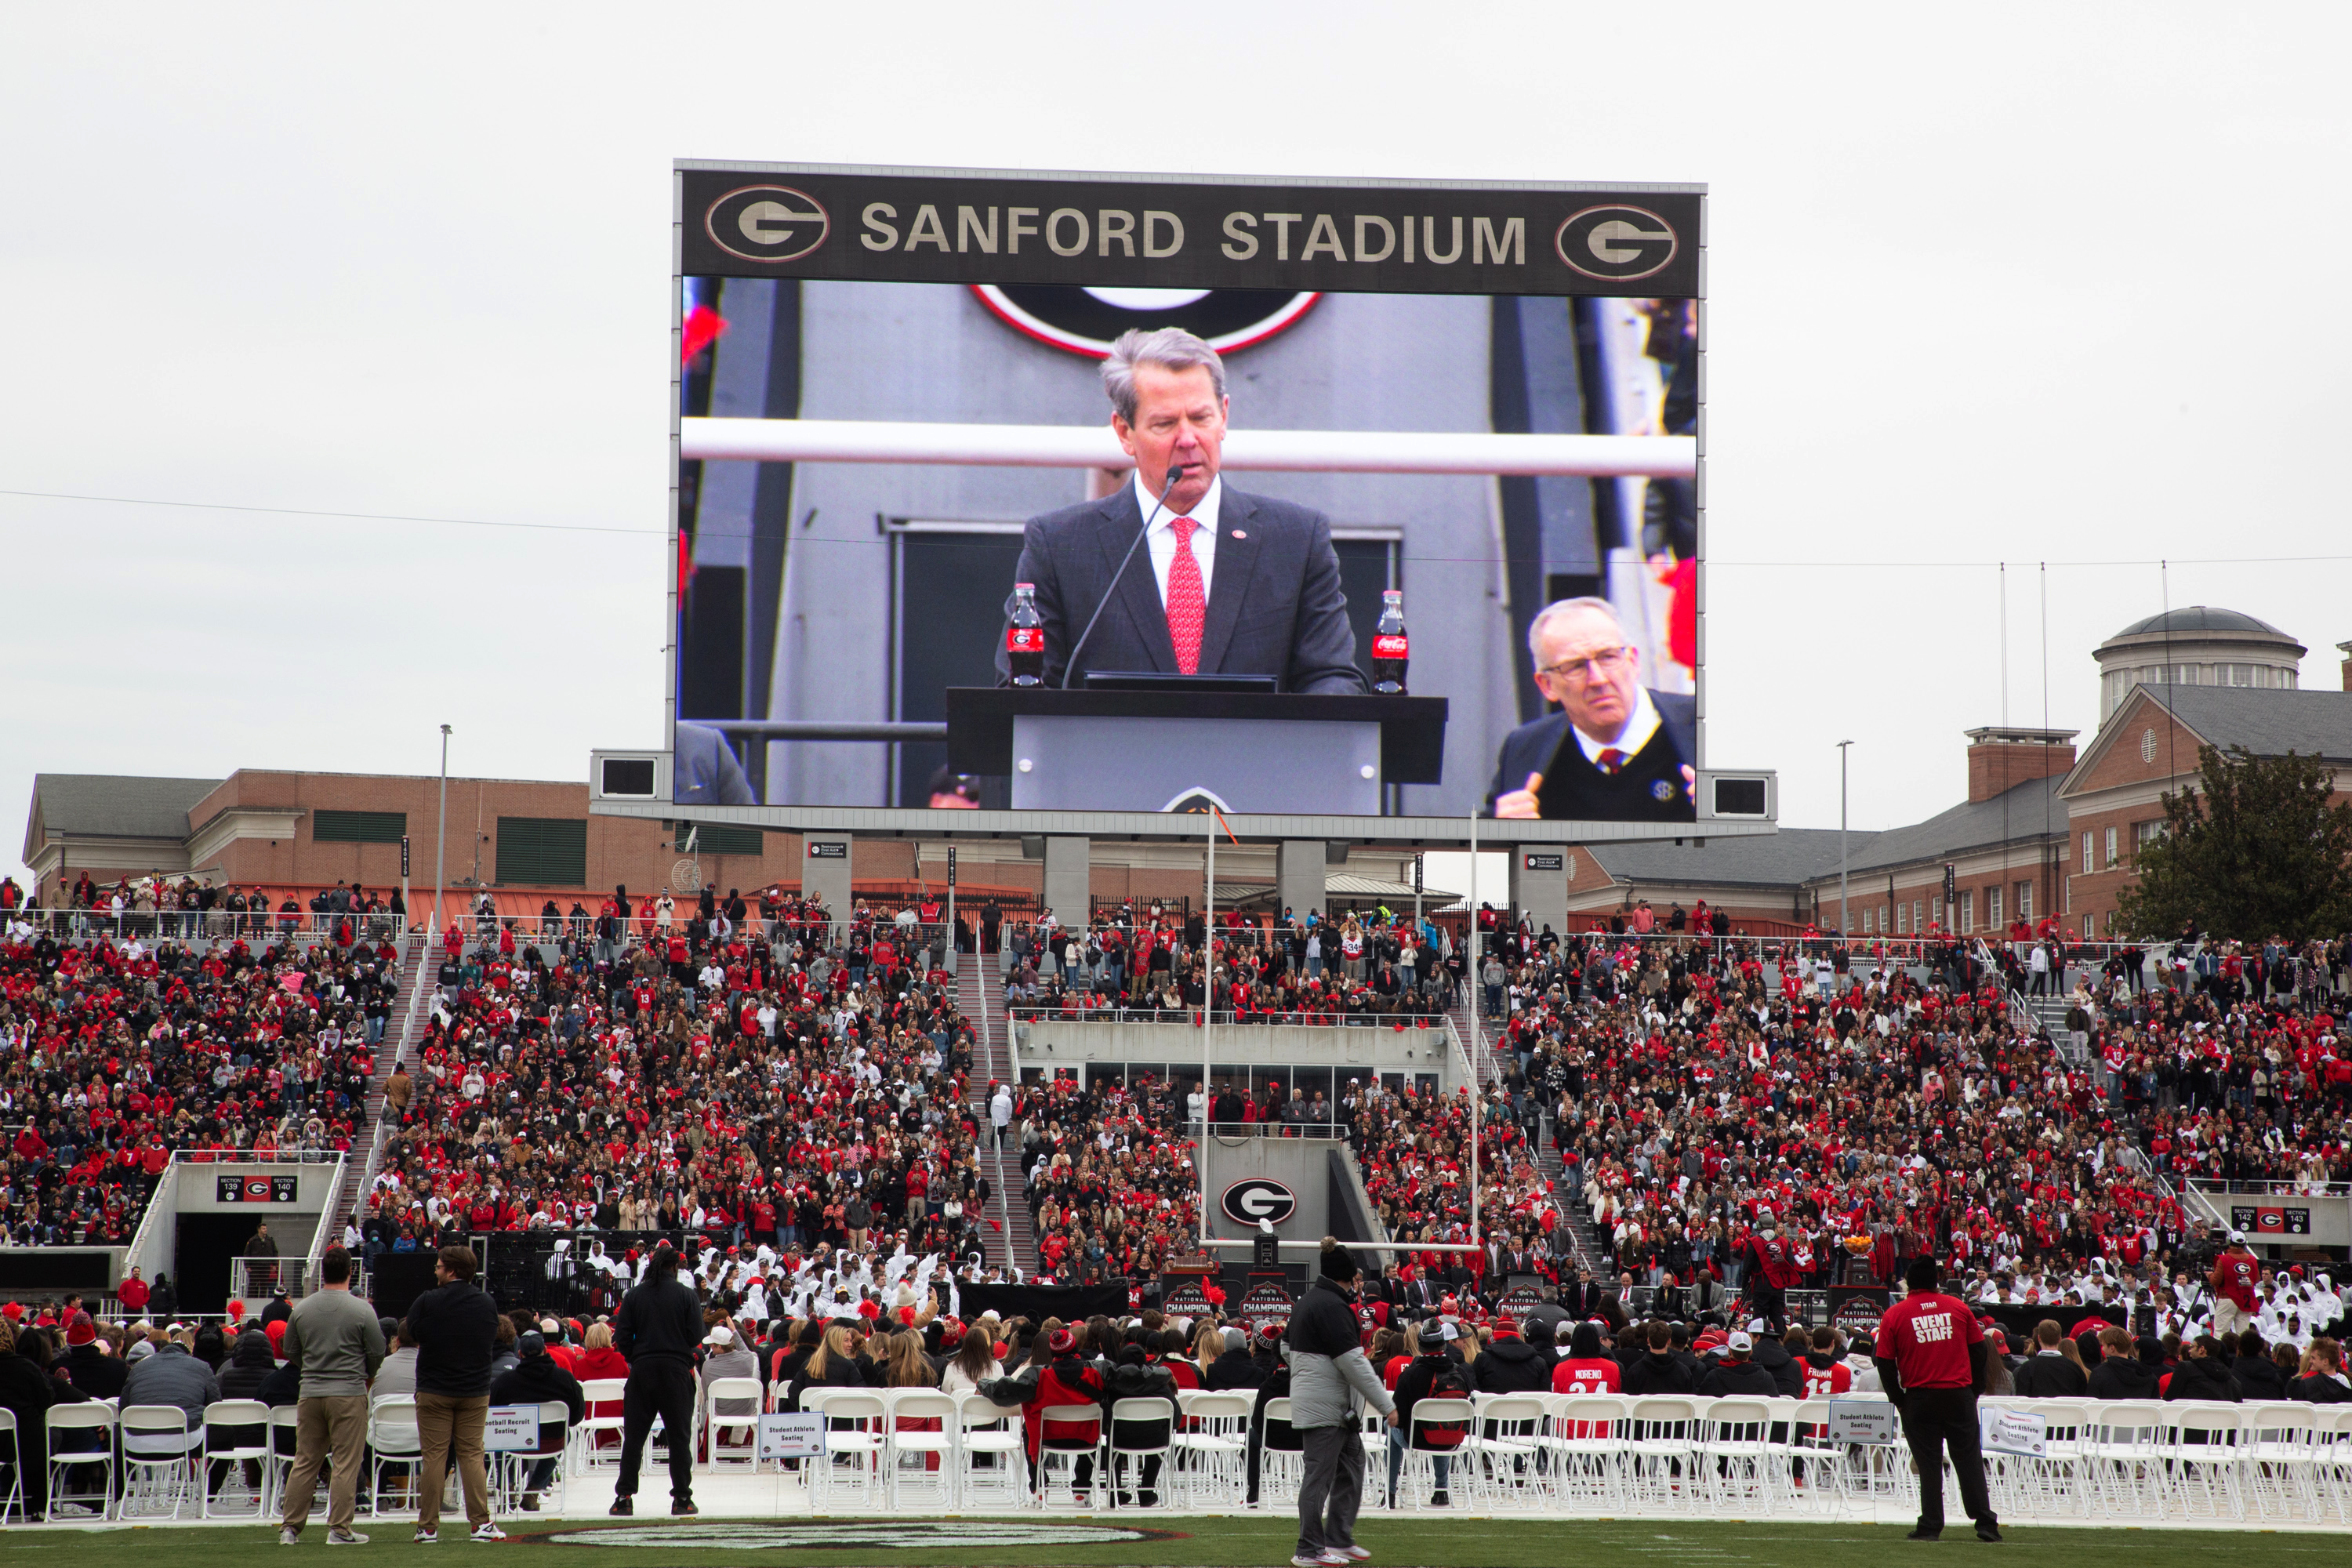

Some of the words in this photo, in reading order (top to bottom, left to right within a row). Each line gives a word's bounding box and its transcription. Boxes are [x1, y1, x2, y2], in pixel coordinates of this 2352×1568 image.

[860, 201, 1185, 259] SANFORD
[1221, 211, 1525, 264] STADIUM
[1348, 943, 1359, 952] 34
[2053, 948, 2059, 957] 3
[1138, 956, 1148, 966] 22
[1428, 985, 1439, 993] 34
[1791, 982, 1795, 992] 1
[1240, 988, 1243, 997] 1
[641, 994, 650, 1004] 13
[712, 1007, 722, 1016] 34
[842, 1017, 847, 1025] 7
[604, 1039, 610, 1048] 7
[2113, 1051, 2122, 1062] 13
[2303, 1053, 2309, 1062] 3
[1830, 1072, 1838, 1081] 10
[630, 1080, 636, 1091] 8
[127, 1153, 133, 1163] 7
[1755, 1149, 1759, 1159] 1
[2180, 1163, 2191, 1173] 34
[1966, 1196, 1974, 1207] 7
[1757, 1203, 1763, 1214] 8
[2167, 1232, 2176, 1244] 11
[2105, 1240, 2118, 1251] 34
[1780, 1271, 1791, 1286] 17
[1920, 1301, 1937, 1311] TITAN
[2243, 1294, 2252, 1308] 2
[1166, 1304, 1210, 1314] CHAMPION
[1243, 1304, 1292, 1314] CHAMPIONS
[1835, 1317, 1883, 1327] CHAMPION
[1911, 1312, 1951, 1331] EVENT
[1915, 1326, 1953, 1344] STAFF
[1575, 1370, 1602, 1380] MORENO
[1806, 1378, 1832, 1396] 11
[1998, 1419, 2017, 1431] Student
[2018, 1425, 2038, 1434] Athlete
[2007, 1431, 2028, 1442] Seating
